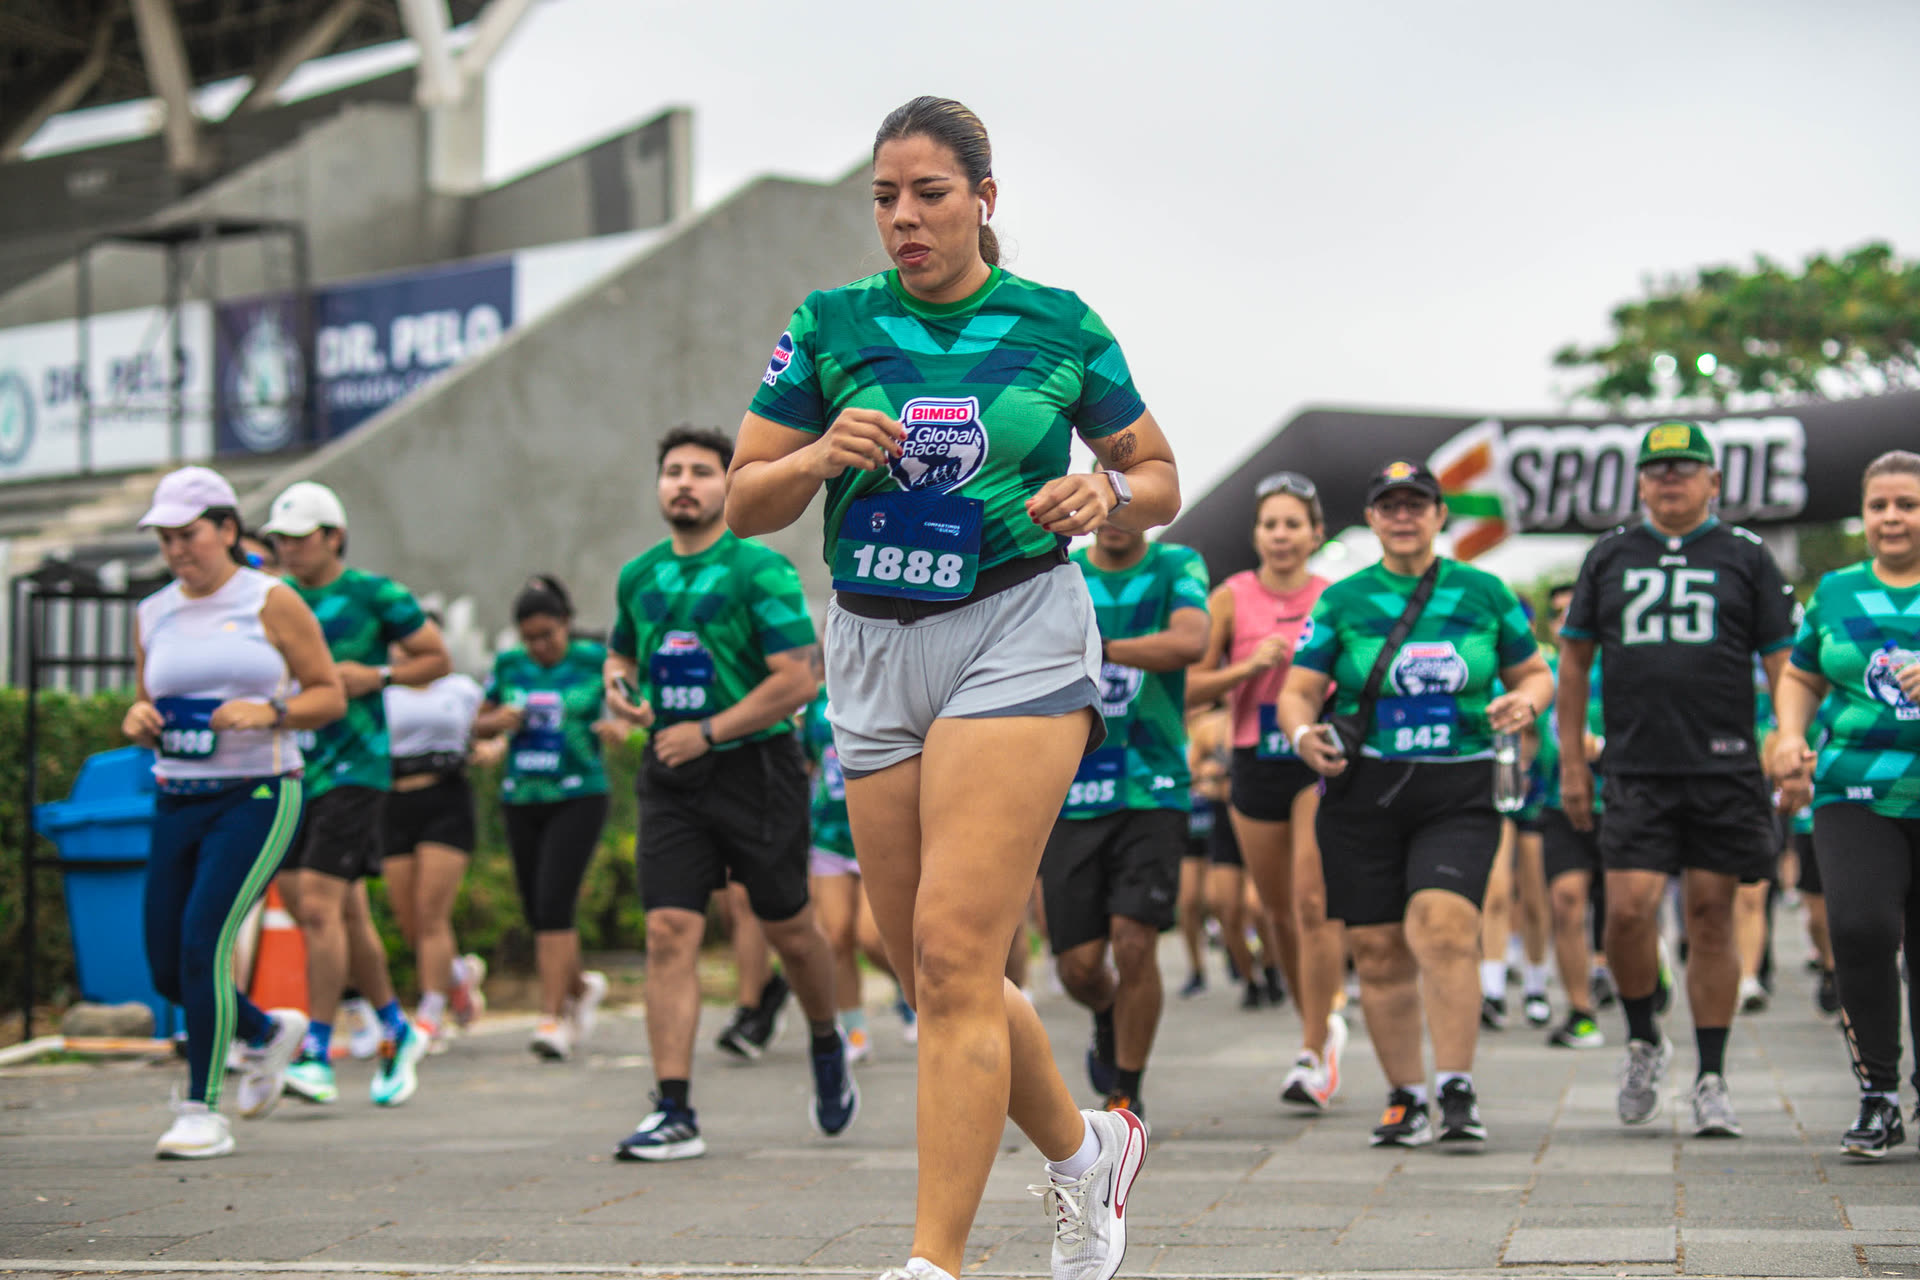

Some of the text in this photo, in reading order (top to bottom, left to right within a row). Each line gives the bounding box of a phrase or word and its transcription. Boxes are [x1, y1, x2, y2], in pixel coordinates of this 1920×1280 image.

[317, 304, 501, 377] DR. PELO
[911, 407, 968, 420] BIMBO
[903, 441, 948, 456] Race
[915, 427, 976, 444] Global
[1504, 428, 1804, 524] SPODE
[853, 544, 963, 588] 1888
[1622, 568, 1717, 645] 25
[661, 686, 706, 709] 959
[1395, 724, 1451, 751] 842
